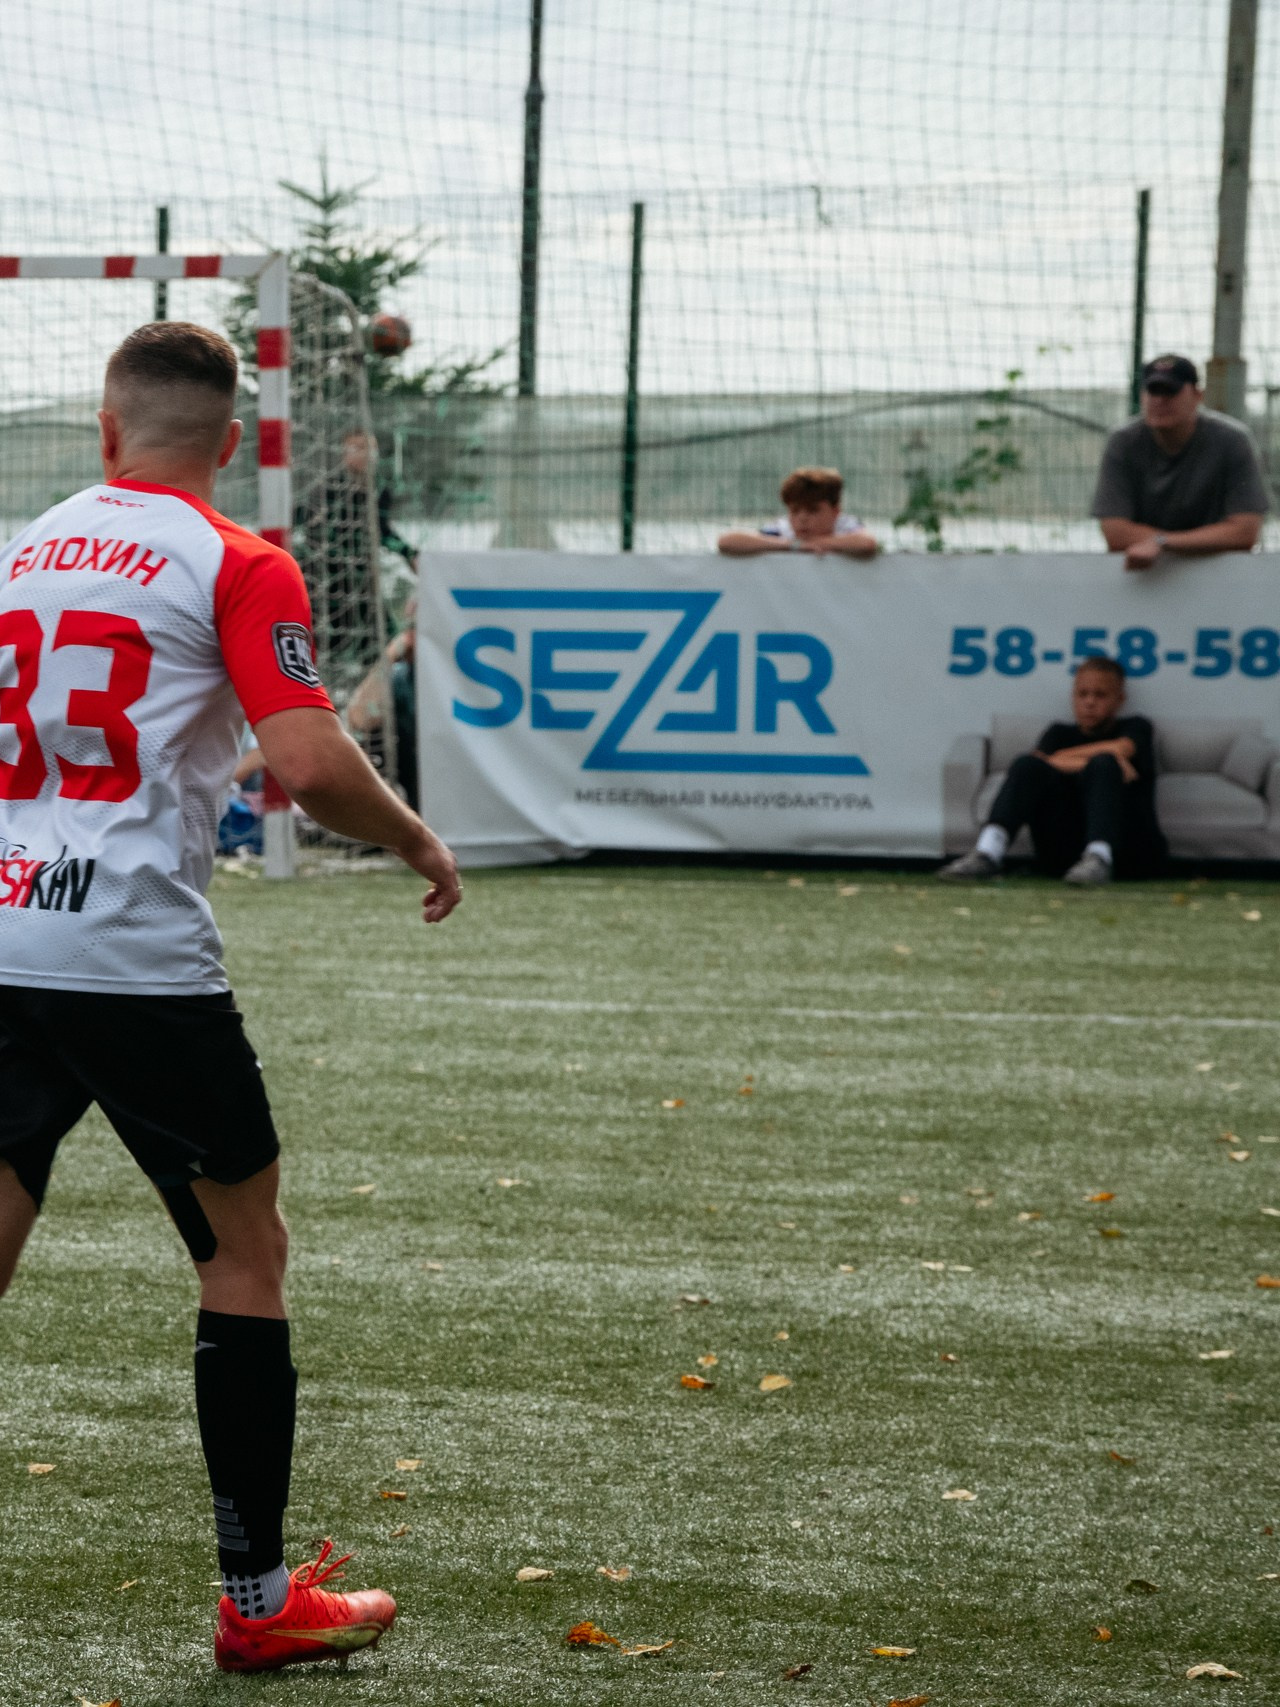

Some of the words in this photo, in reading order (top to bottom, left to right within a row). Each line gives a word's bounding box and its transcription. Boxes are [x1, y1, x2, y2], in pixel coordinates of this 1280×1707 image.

[9, 536, 170, 587] БЛОХИН
[946, 625, 1280, 678] 58-58-58
[450, 588, 872, 776] SEZAR
[574, 787, 706, 807] МЕБЕЛЬНАЯ
[711, 789, 874, 811] МАНУФАКТУРА
